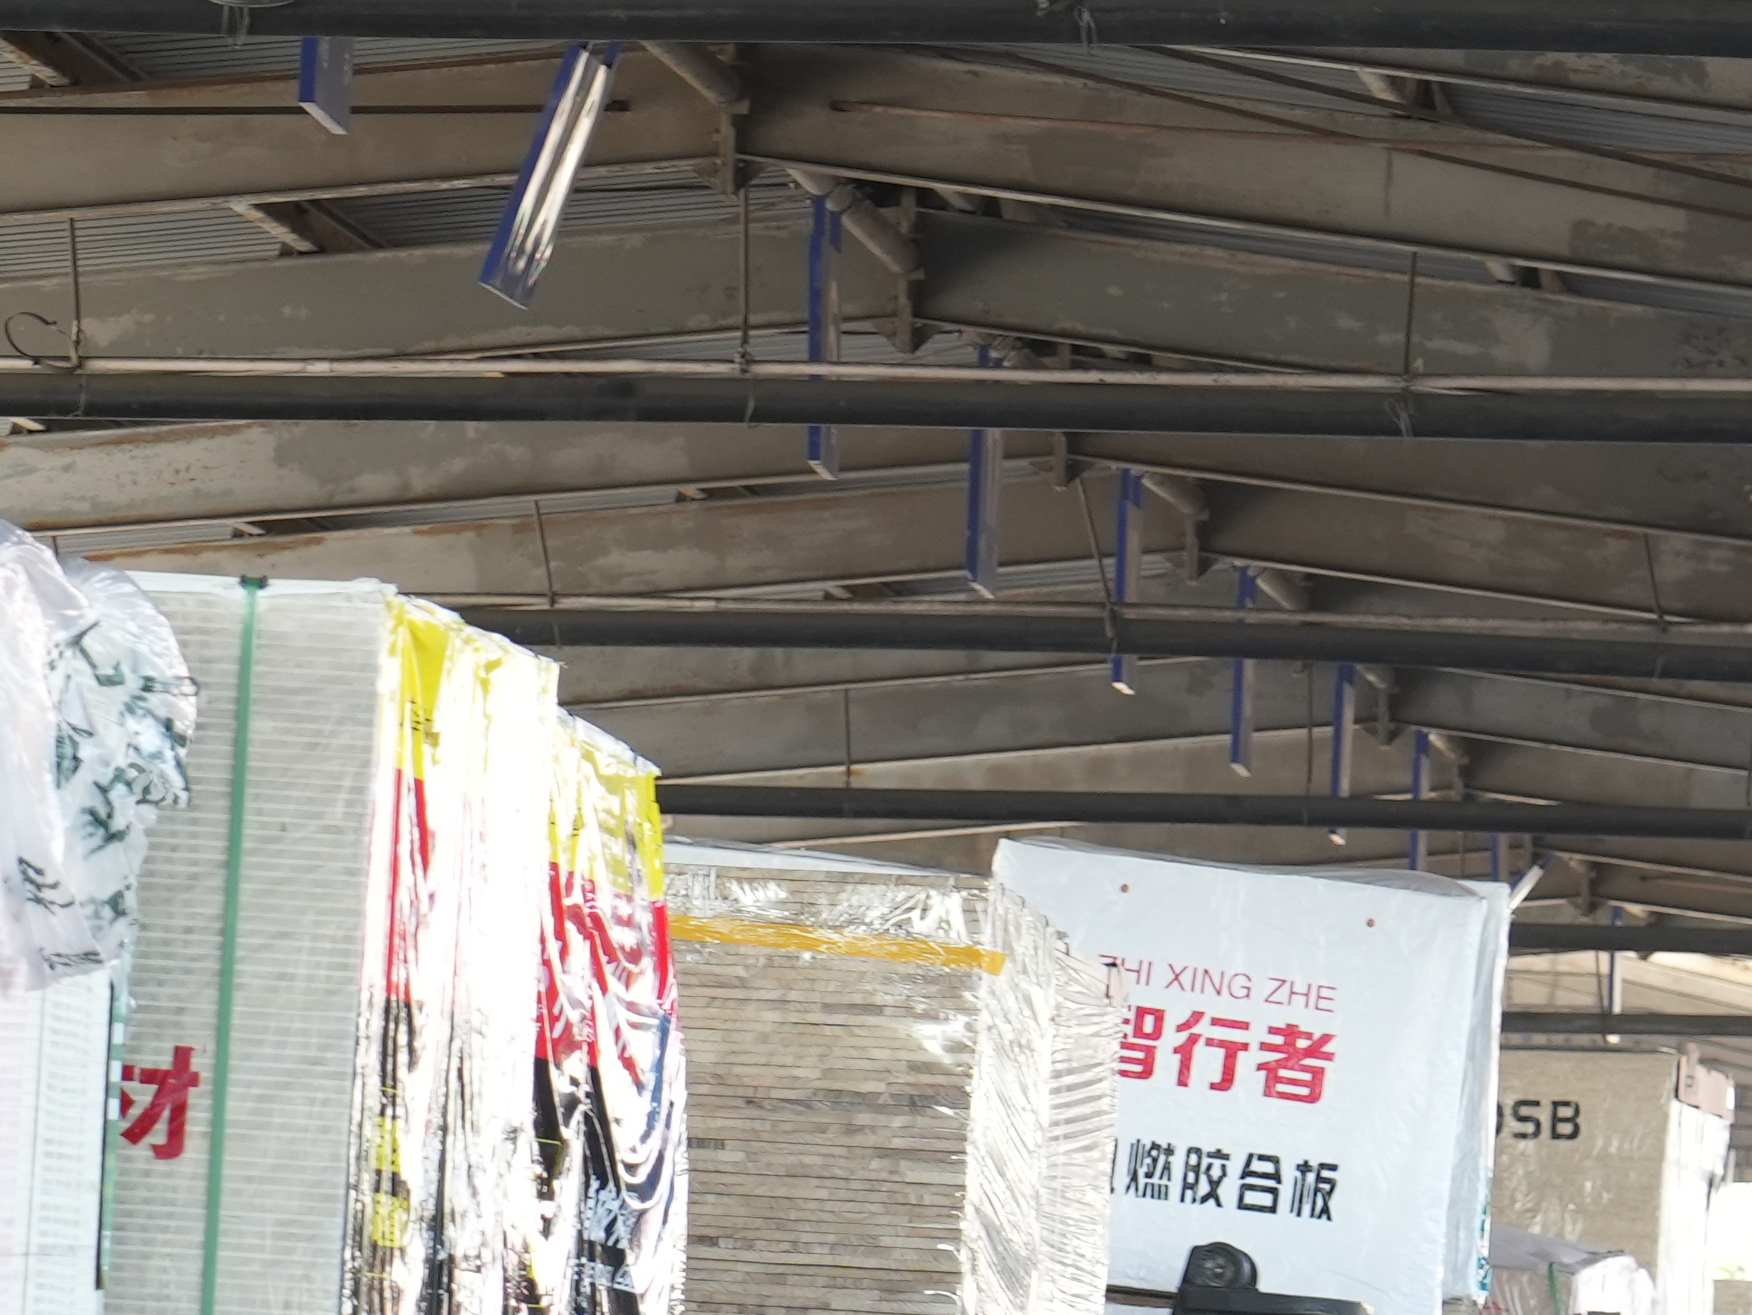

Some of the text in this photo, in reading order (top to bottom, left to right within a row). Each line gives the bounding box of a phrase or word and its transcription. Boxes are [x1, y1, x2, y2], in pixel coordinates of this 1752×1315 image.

[1099, 954, 1337, 1012] HI XING ZHE
[1118, 1005, 1337, 1104] 智行者
[1496, 1099, 1581, 1140] SB
[1110, 1138, 1339, 1222] 燃胶合板
